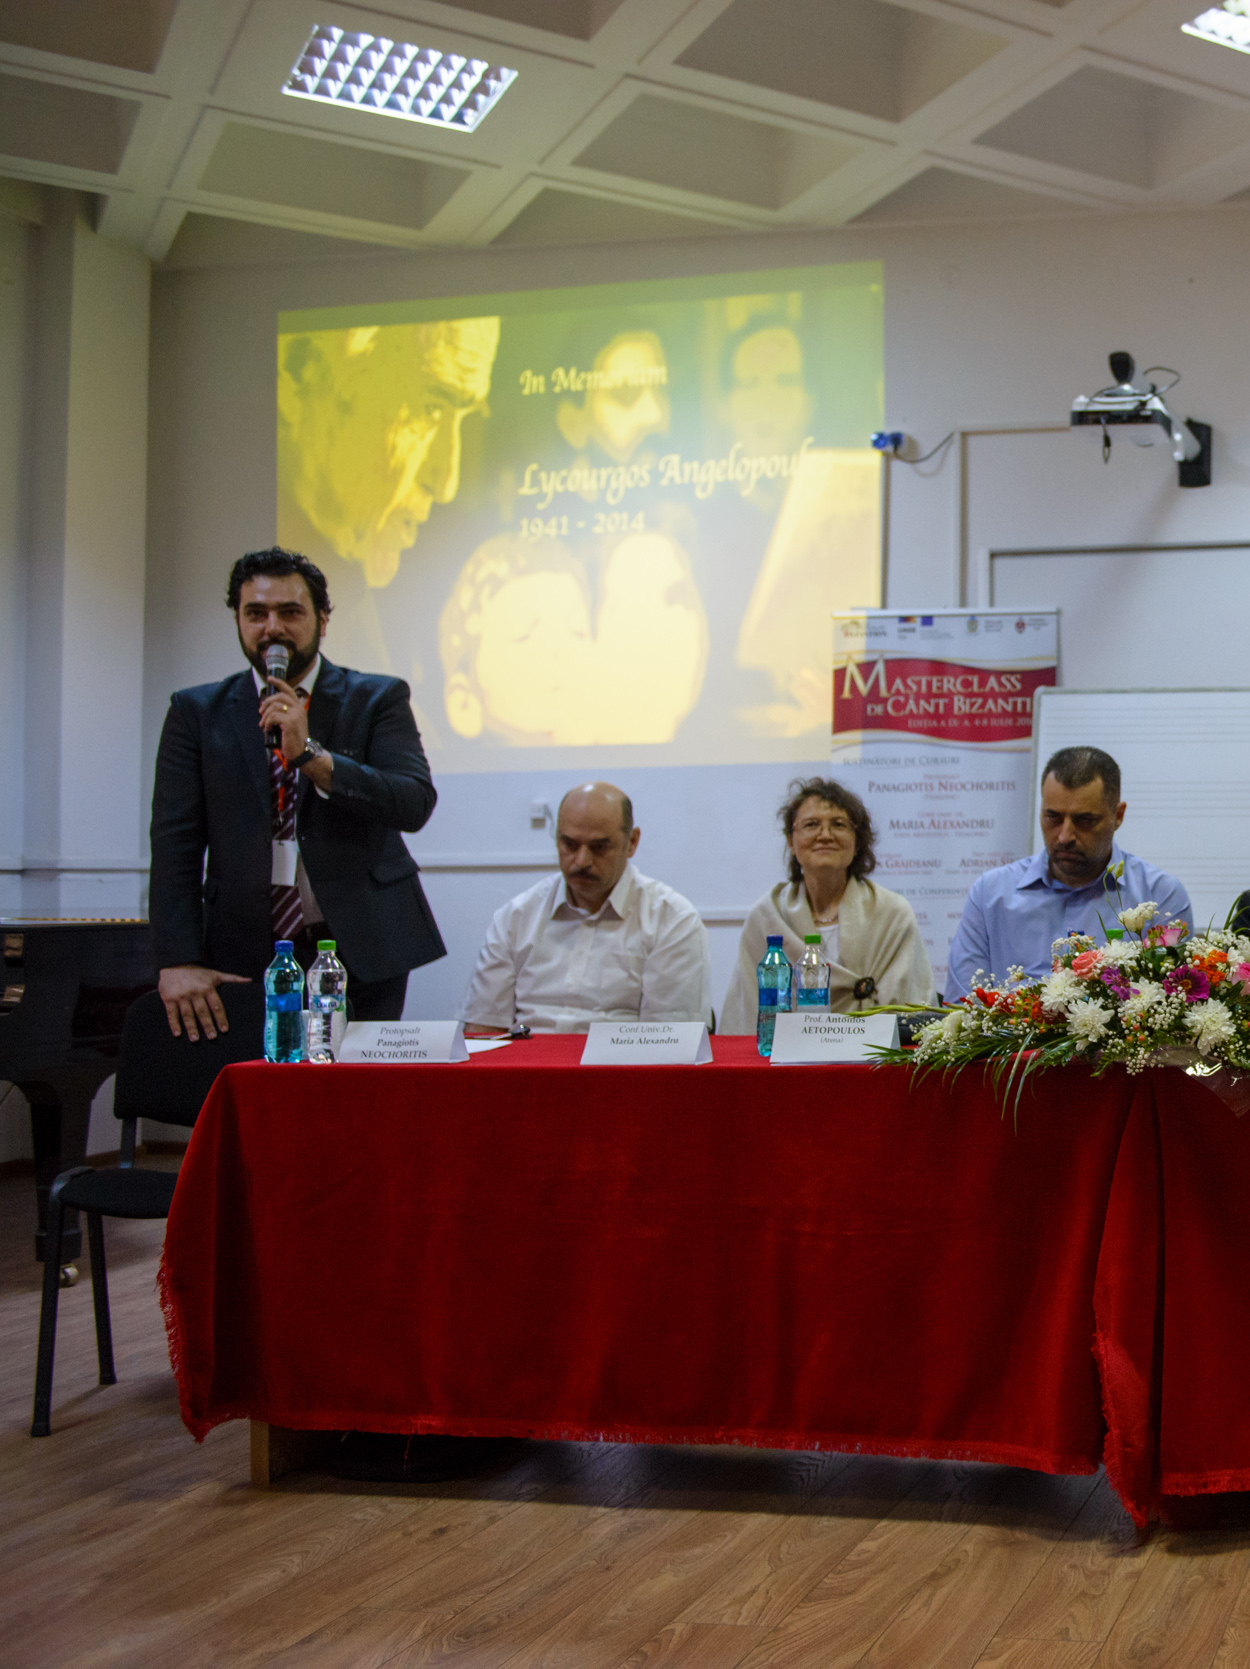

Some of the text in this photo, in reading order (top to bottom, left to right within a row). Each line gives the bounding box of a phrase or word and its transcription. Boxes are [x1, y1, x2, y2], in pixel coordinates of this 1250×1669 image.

[520, 370, 545, 395] In
[518, 463, 651, 510] Lycourgos
[520, 515, 569, 542] 1941
[593, 511, 645, 534] 2014
[841, 654, 1022, 699] MASTERCLASS
[867, 694, 1032, 717] DE CÂNT BIZANTI
[868, 779, 1016, 793] PANAGIOTIS NEOCHORITIS
[889, 818, 994, 830] MARIA ALEXANDRU
[804, 1015, 823, 1023] Prof.
[801, 1026, 866, 1035] AETOPOULOS
[377, 1039, 419, 1048] Panagiotis
[610, 1036, 679, 1045] Maria Alexandru
[361, 1050, 427, 1059] NEOCHORITIS
